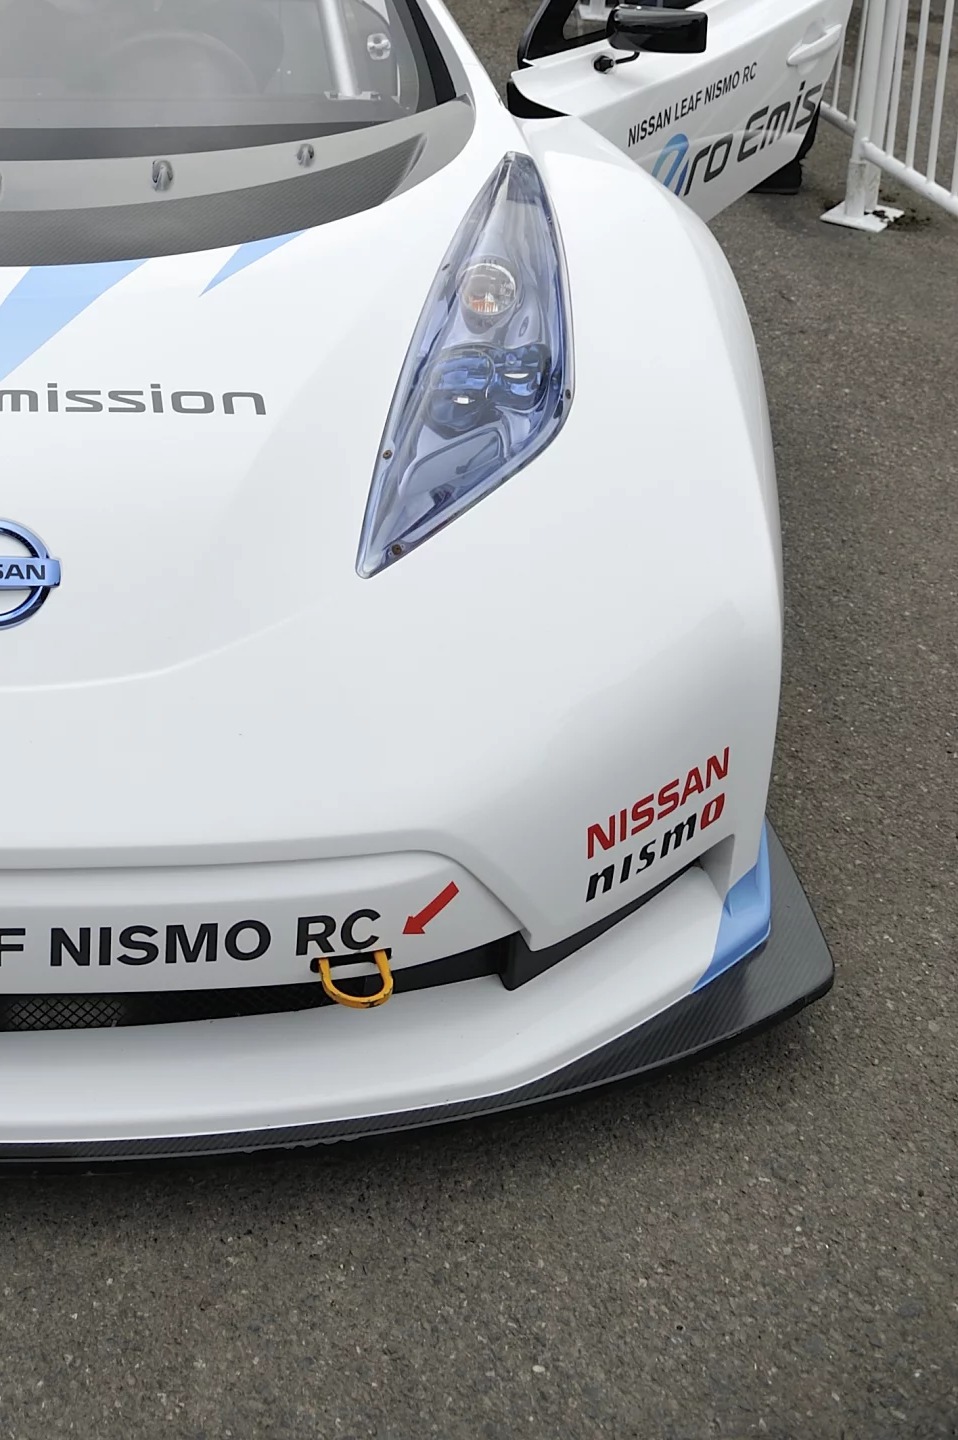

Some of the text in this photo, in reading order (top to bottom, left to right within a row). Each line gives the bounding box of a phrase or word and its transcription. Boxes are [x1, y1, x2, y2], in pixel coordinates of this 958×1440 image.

[628, 61, 758, 148] NISSAN LEAF NISMO RC
[736, 80, 823, 163] Emis
[586, 746, 730, 860] NISSAN
[584, 792, 726, 902] nismo
[50, 919, 273, 968] NISMO
[295, 908, 382, 958] RC
